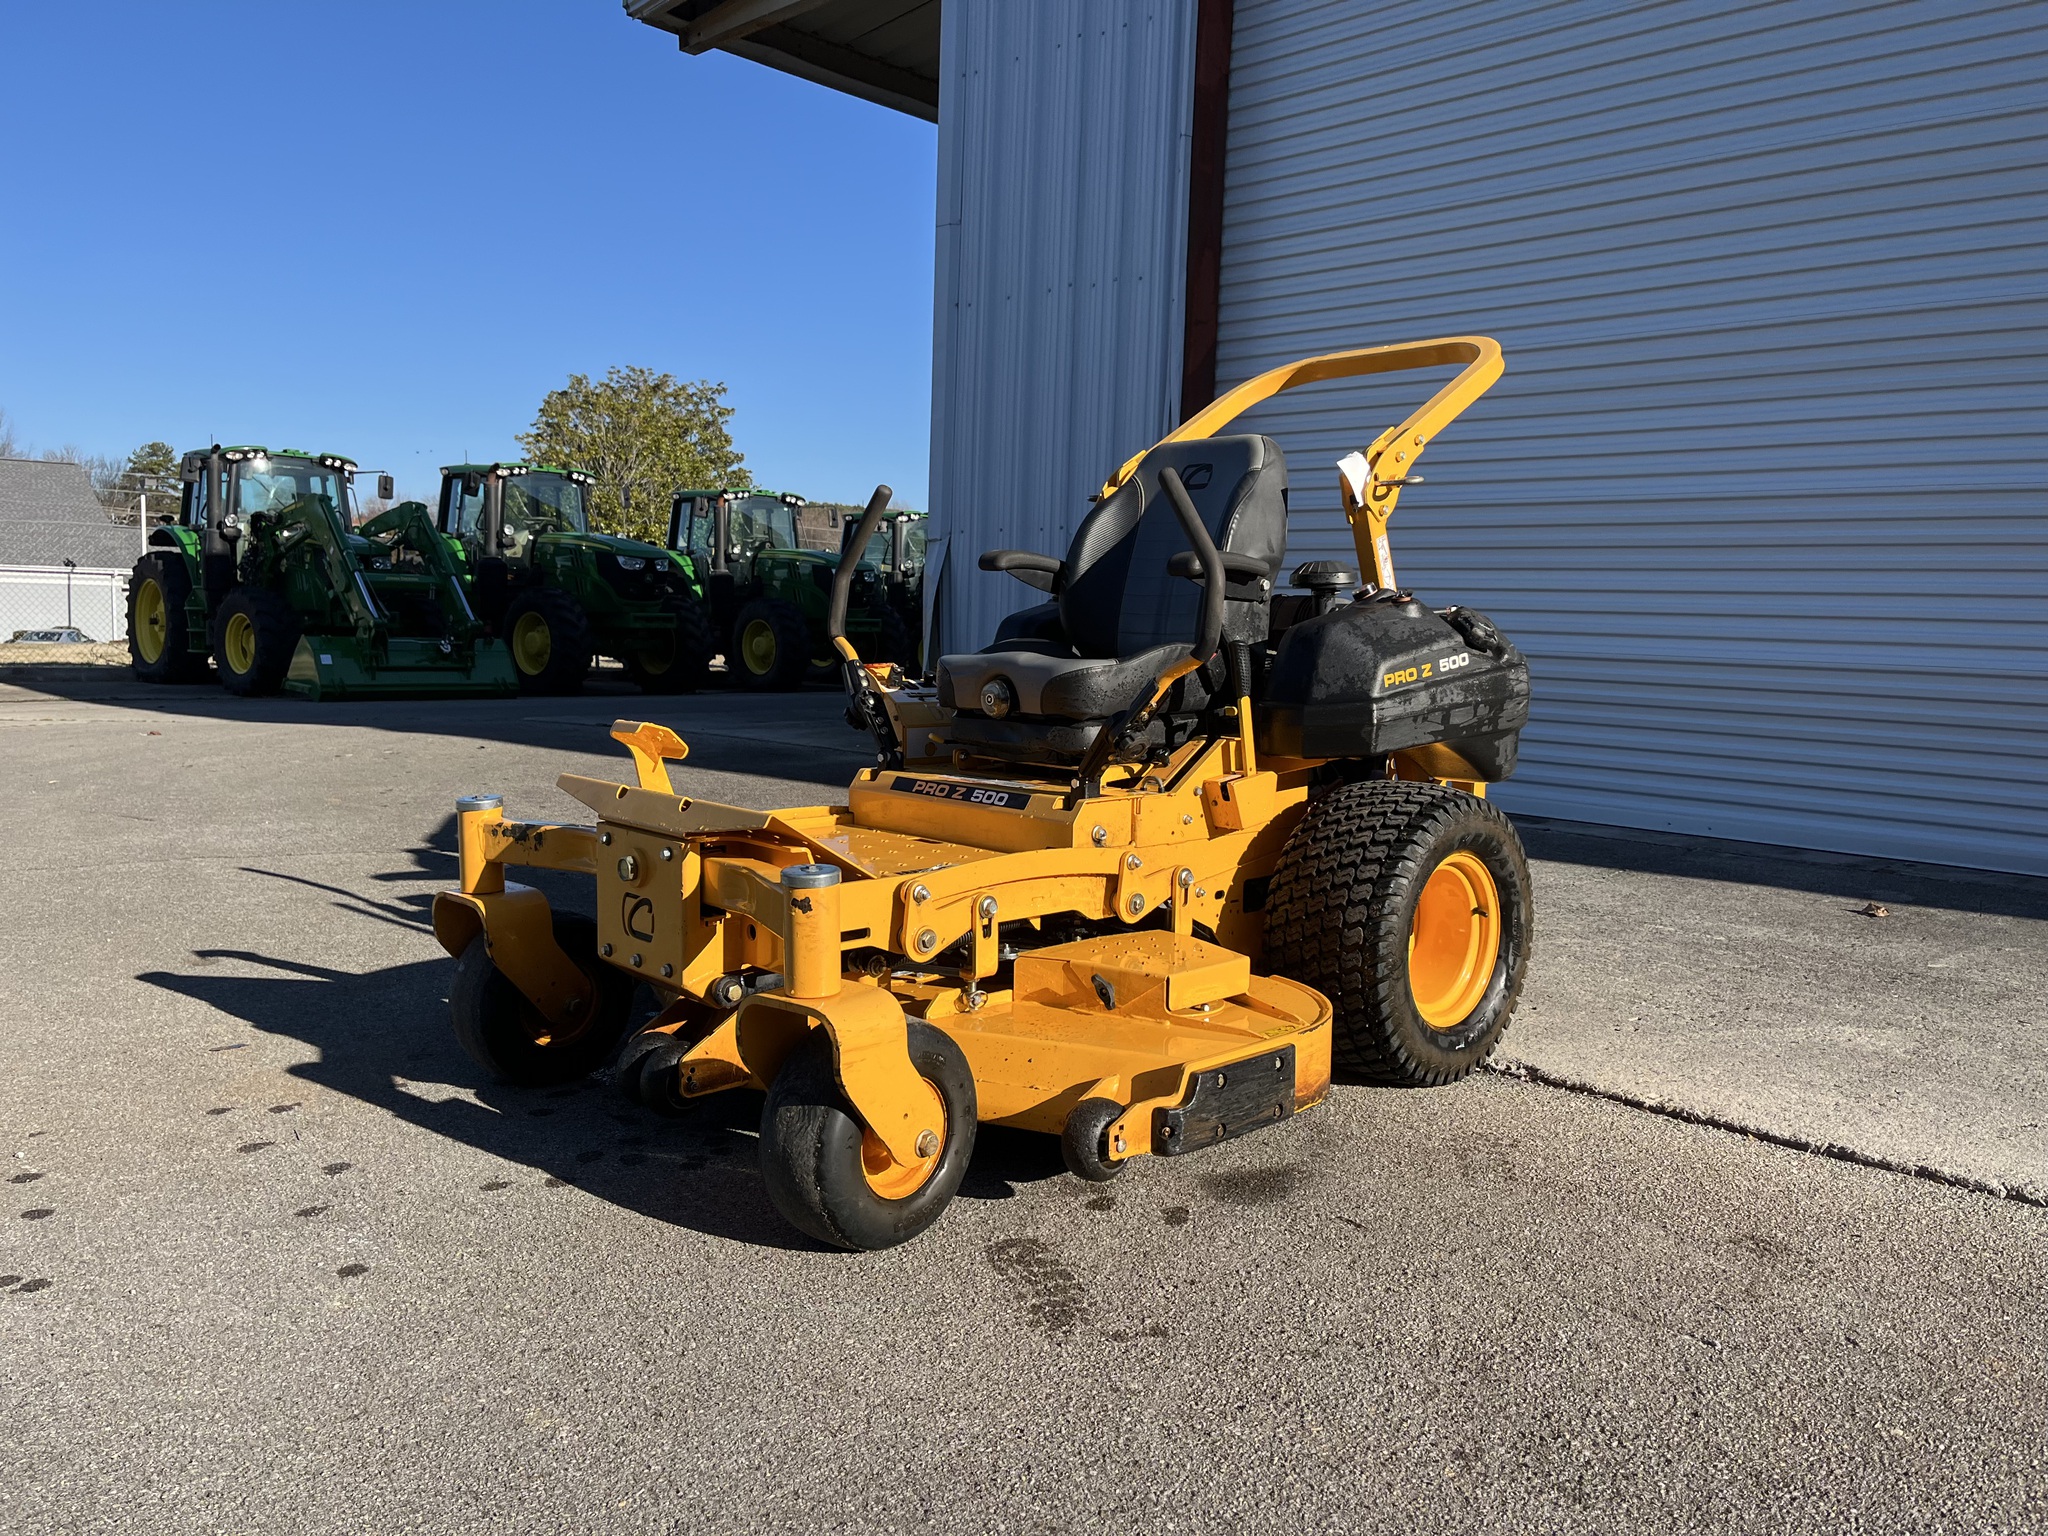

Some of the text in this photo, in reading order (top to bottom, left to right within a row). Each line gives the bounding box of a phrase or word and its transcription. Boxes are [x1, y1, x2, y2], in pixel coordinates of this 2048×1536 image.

[1383, 652, 1470, 688] PRO Z 500
[912, 780, 1009, 806] PRO Z 500
